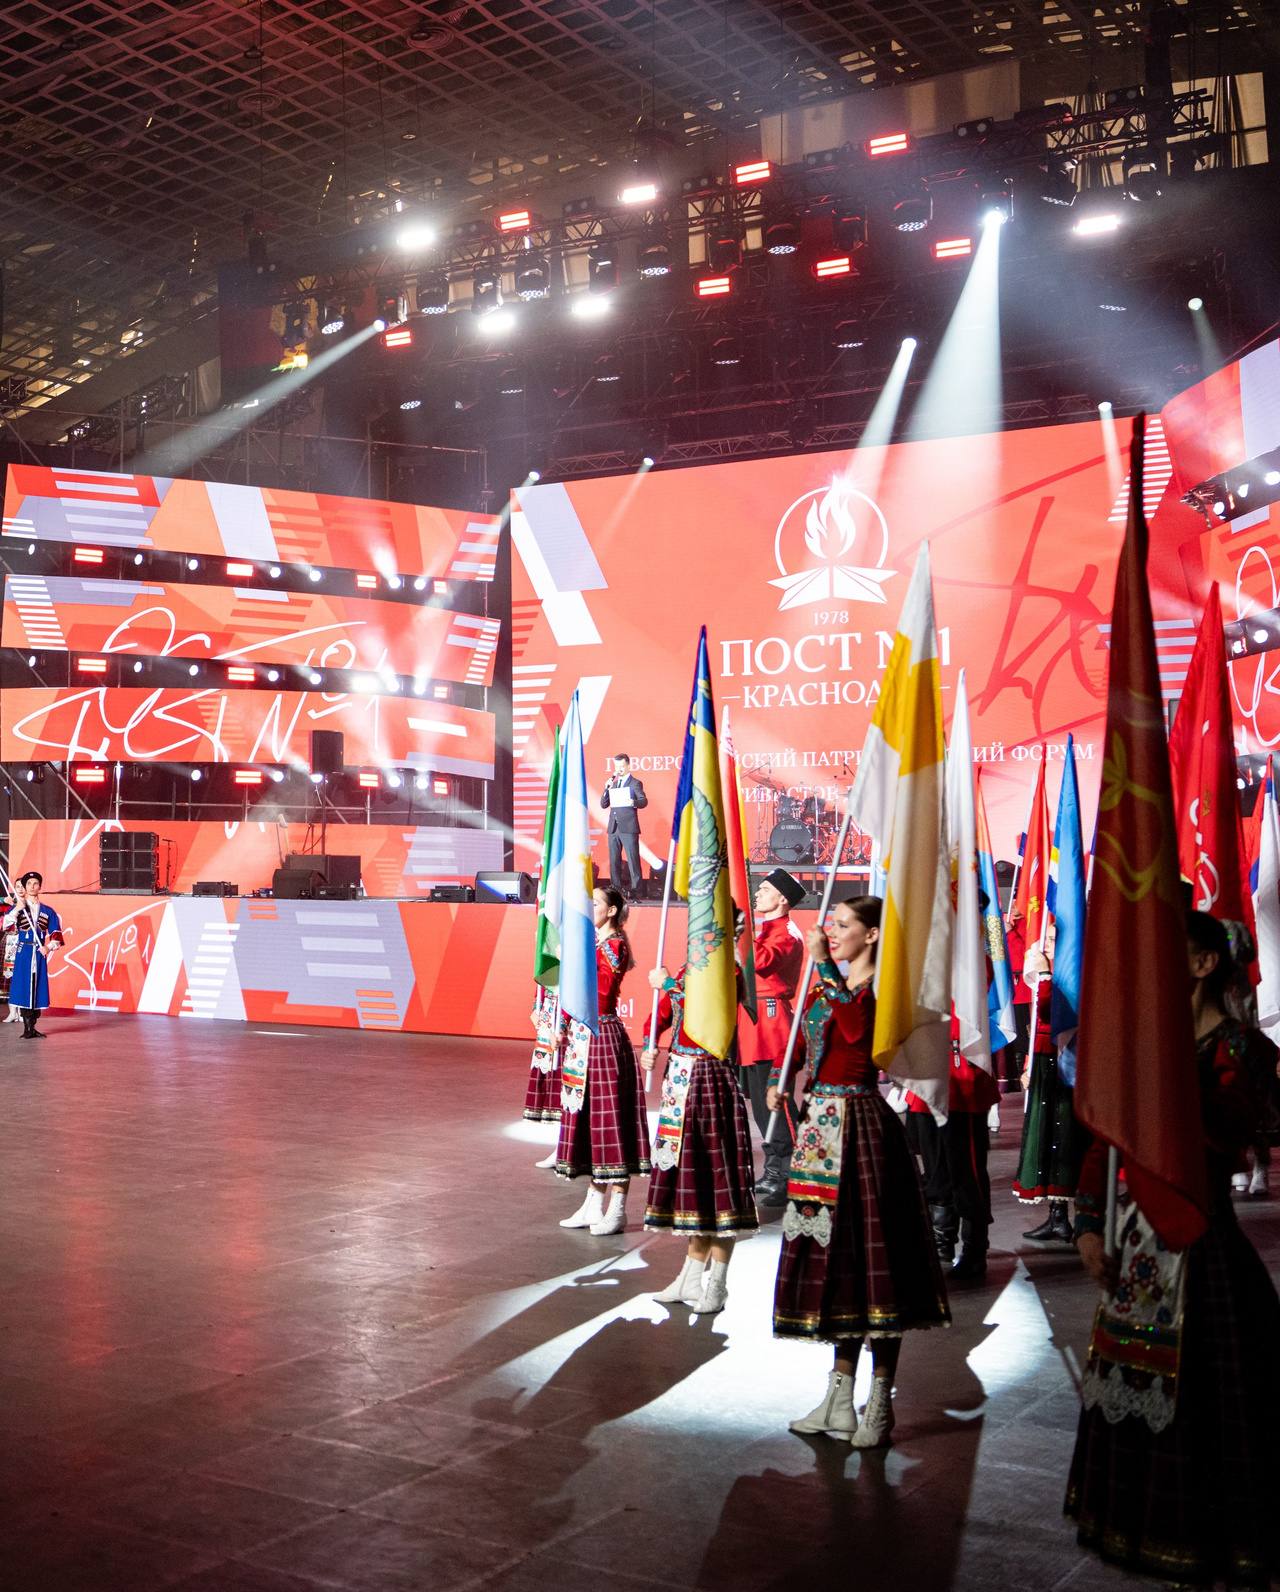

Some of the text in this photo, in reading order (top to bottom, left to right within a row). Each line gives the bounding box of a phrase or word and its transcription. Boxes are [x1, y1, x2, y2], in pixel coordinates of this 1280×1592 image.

[813, 610, 850, 626] 1978
[720, 632, 862, 677] ПОСТ
[743, 679, 883, 709] КРАСНОД
